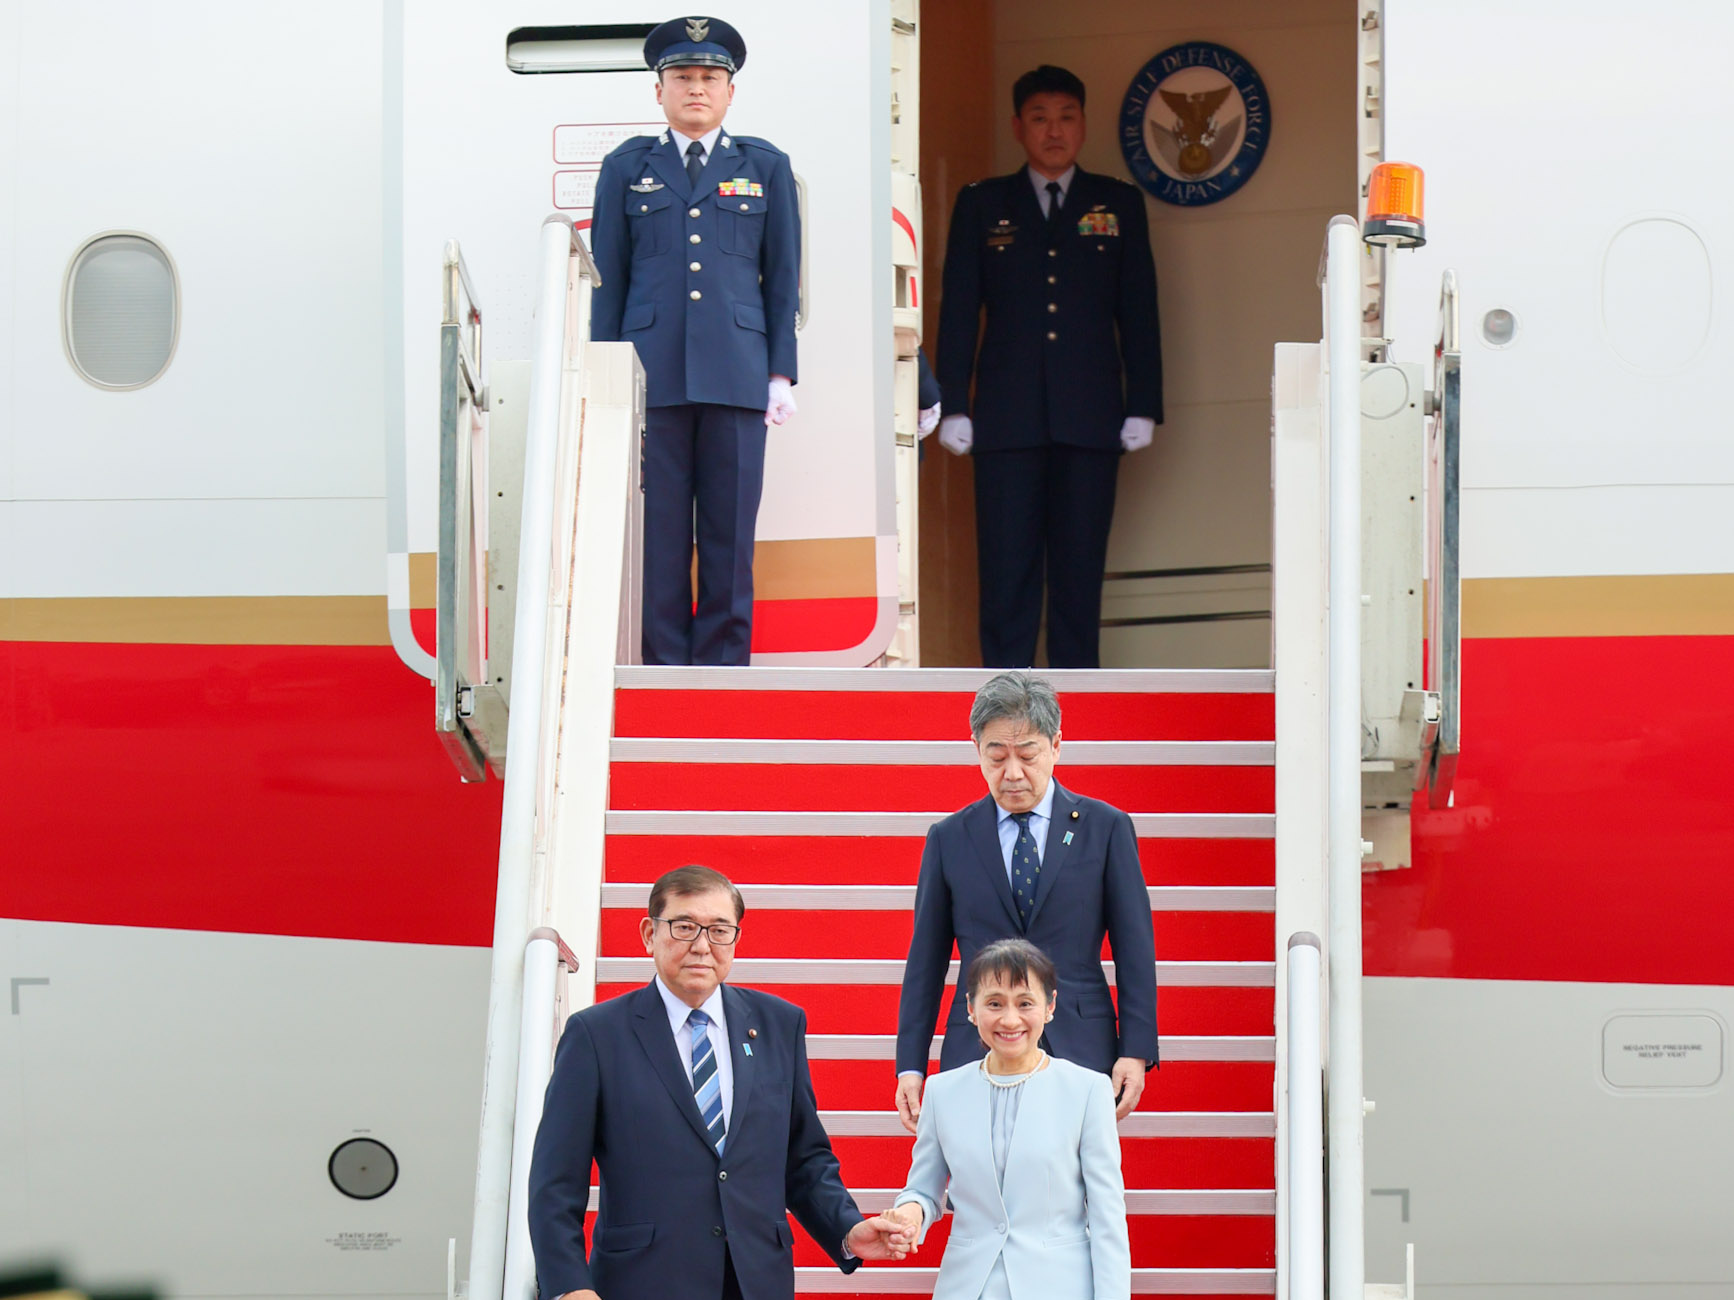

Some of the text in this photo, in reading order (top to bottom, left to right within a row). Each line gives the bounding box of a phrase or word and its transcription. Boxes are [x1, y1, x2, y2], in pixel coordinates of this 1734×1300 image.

[1125, 47, 1263, 160] AIR SELF DEFENSE FORCE
[1162, 179, 1223, 201] JAPAN
